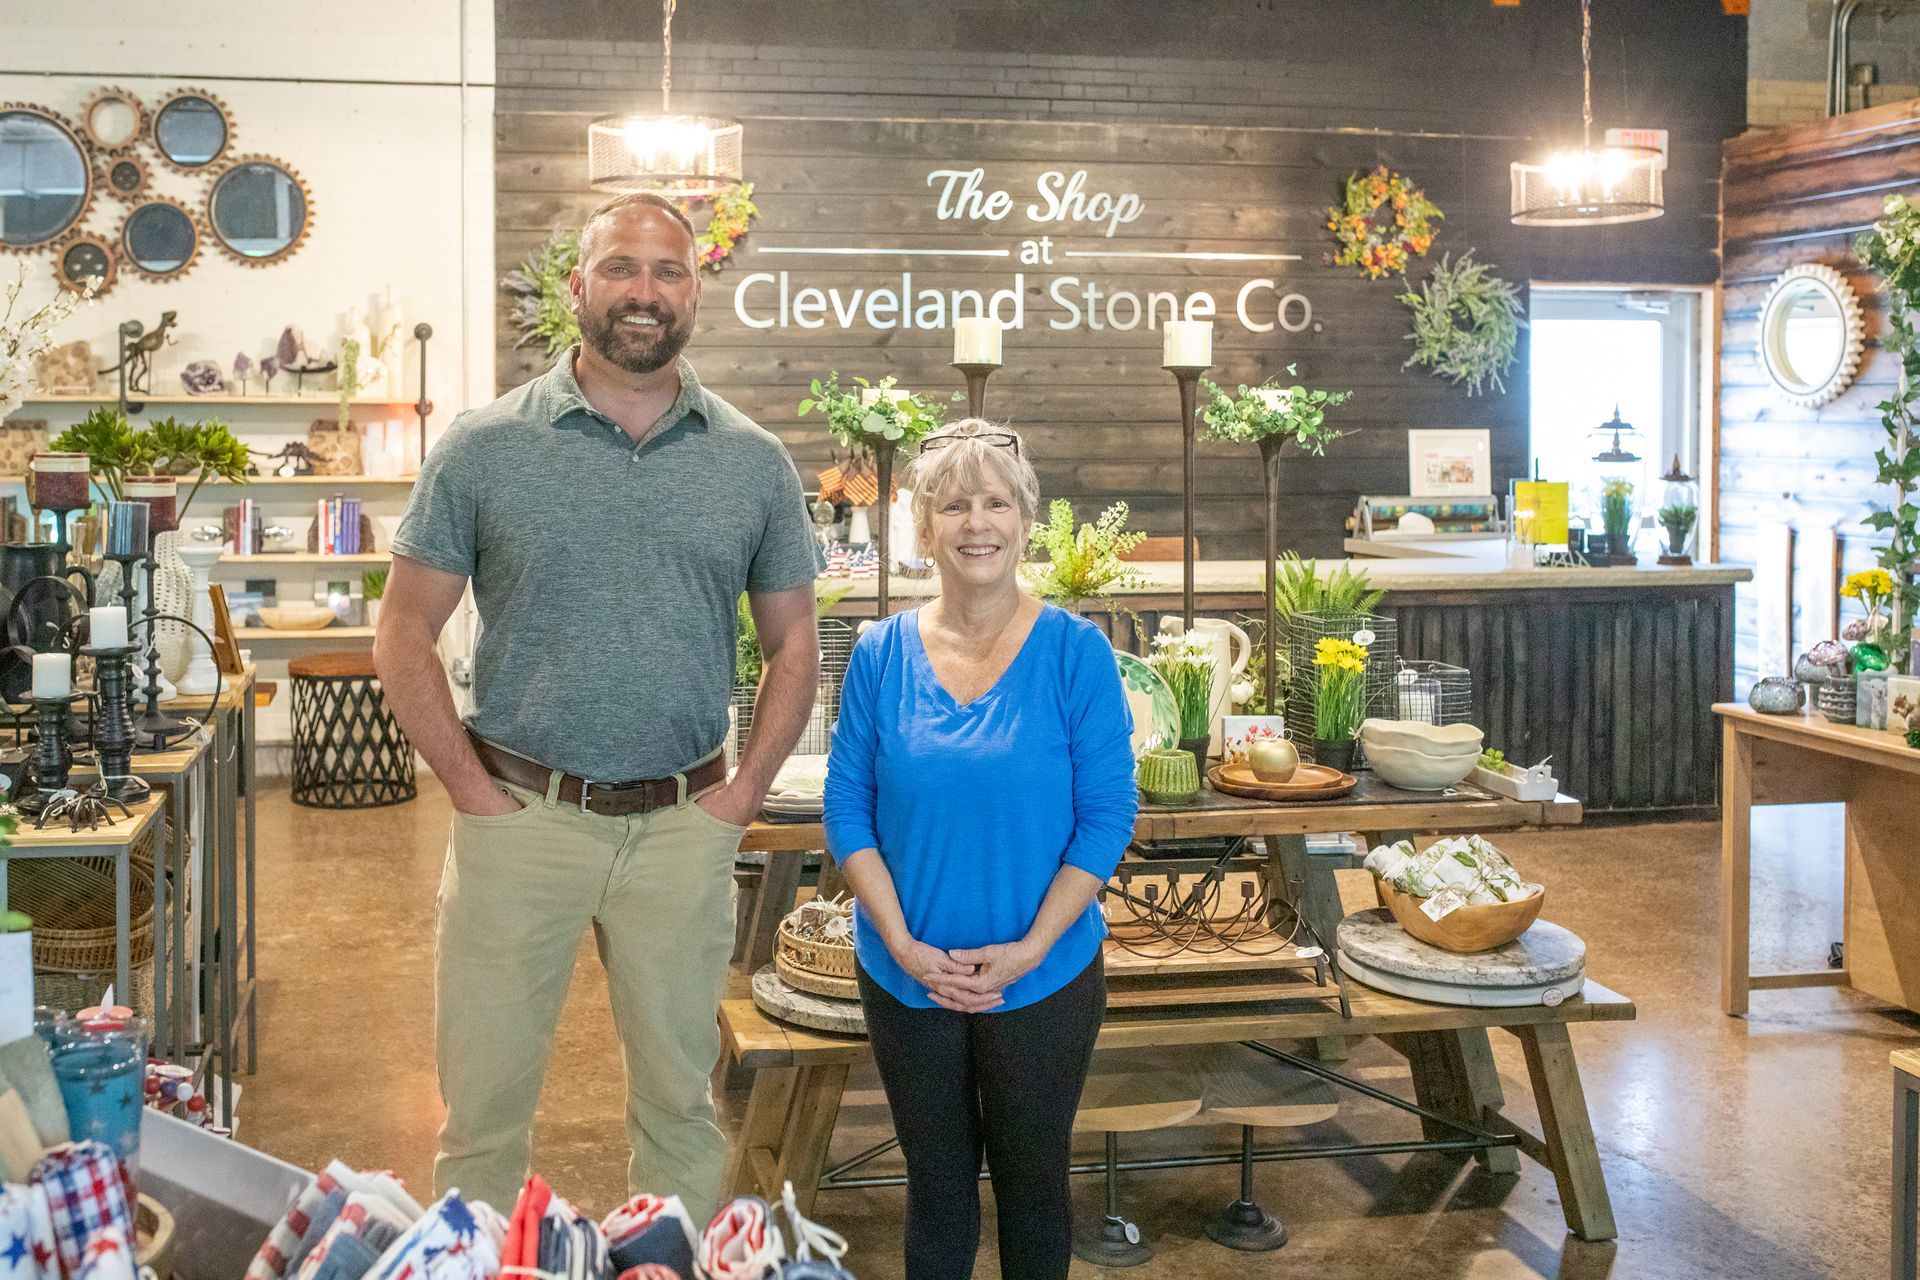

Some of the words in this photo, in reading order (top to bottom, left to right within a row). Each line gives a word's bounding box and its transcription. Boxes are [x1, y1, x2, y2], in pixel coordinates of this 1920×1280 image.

[927, 168, 1013, 220] The
[1026, 169, 1145, 237] Shop
[1019, 236, 1053, 265] at
[733, 270, 1025, 331] Cleveland
[1048, 276, 1216, 331] Stone
[1236, 279, 1323, 333] Co.
